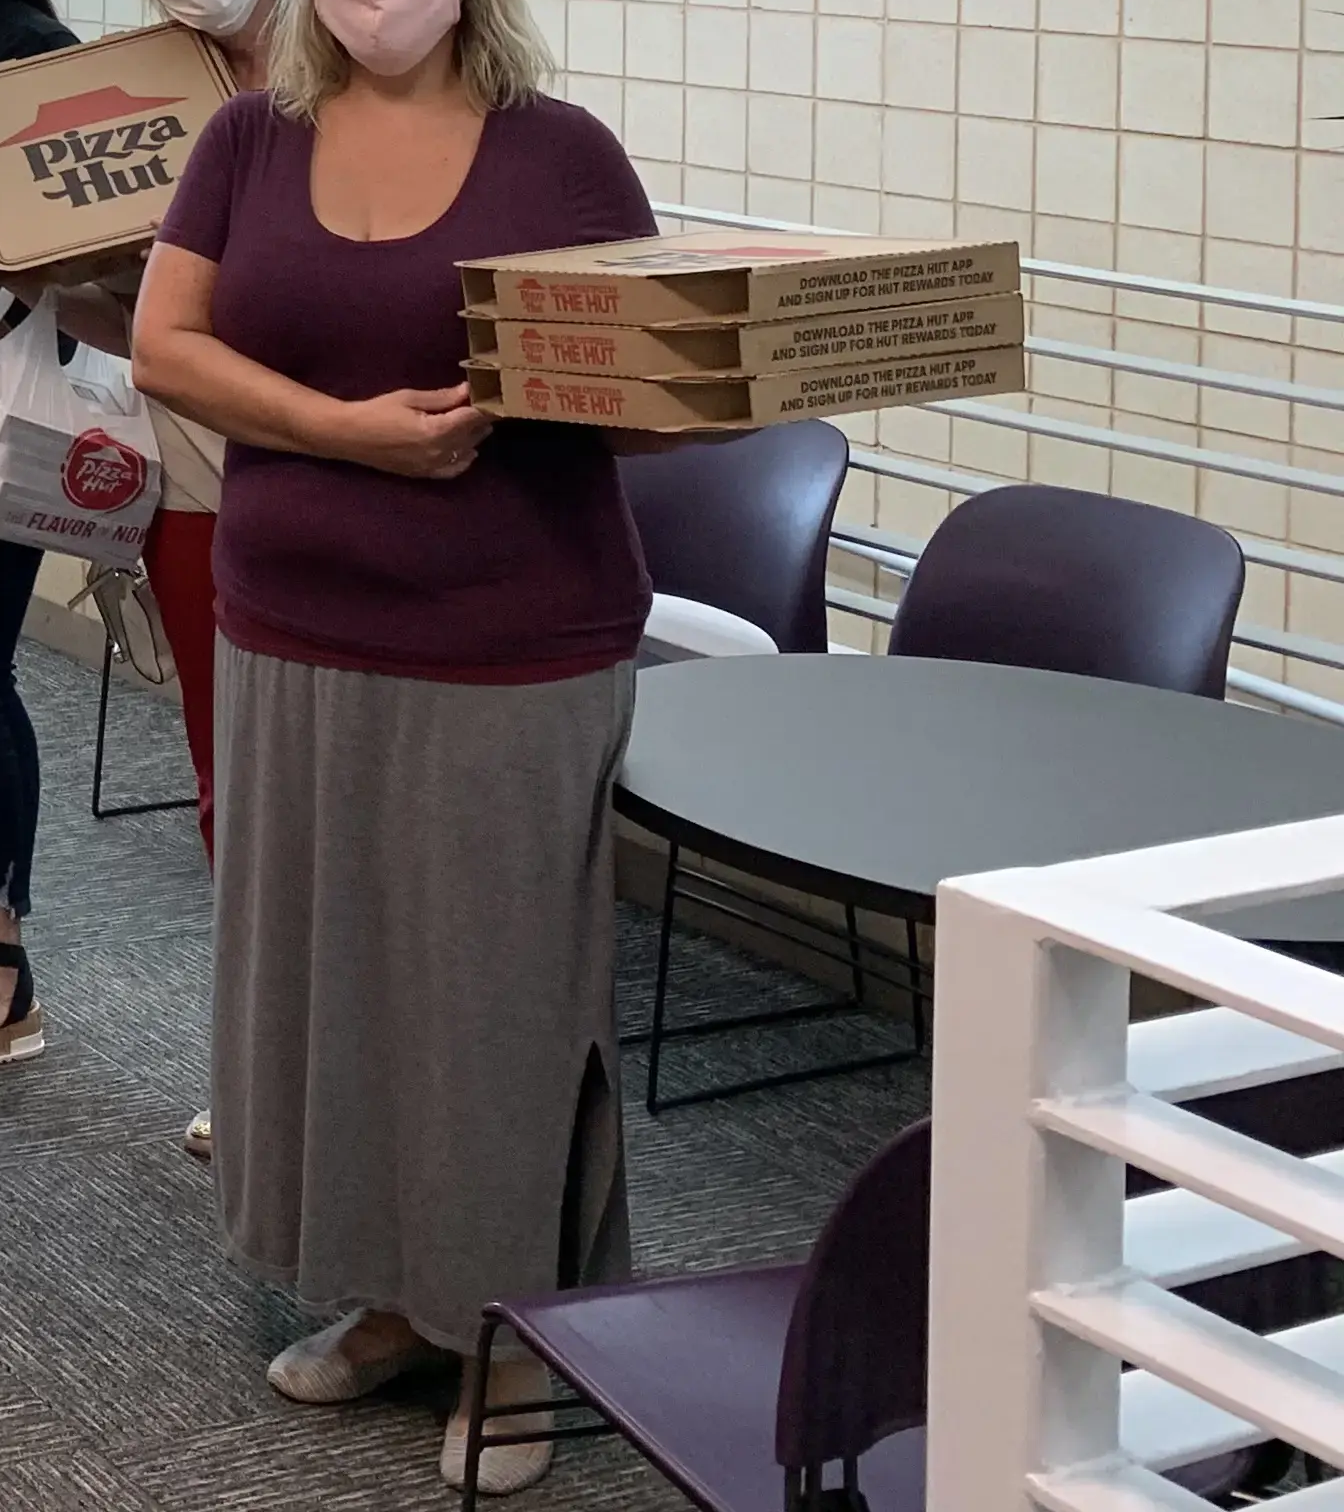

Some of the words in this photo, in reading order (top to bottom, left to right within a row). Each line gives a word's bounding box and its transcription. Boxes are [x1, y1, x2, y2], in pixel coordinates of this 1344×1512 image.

[20, 115, 188, 182] Pizza
[42, 155, 175, 208] Hut
[778, 294, 801, 307] AND
[805, 290, 833, 304] SIGN
[835, 288, 849, 300] UP
[853, 285, 876, 298] FOR
[878, 282, 900, 296] HUT
[902, 276, 954, 292] REWARDS
[958, 271, 994, 285] TODAY
[800, 271, 867, 290] DOWNLOAD
[872, 268, 891, 280] THE
[893, 264, 924, 278] PIZZA
[927, 261, 949, 274] HUT
[952, 259, 973, 270] APP
[551, 292, 583, 312] THE
[586, 294, 620, 314] HUT
[772, 348, 797, 361] AND
[800, 344, 828, 358] SIGN
[831, 341, 846, 353] UP
[850, 338, 873, 351] FOR
[876, 335, 898, 348] HUT
[902, 328, 956, 345] REWARDS
[959, 323, 997, 337] TODAY
[794, 324, 864, 343] DOWNLOAD
[868, 320, 889, 333] THE
[892, 316, 923, 330] PIZZA
[927, 314, 949, 327] HUT
[952, 311, 974, 323] APP
[550, 343, 581, 363] THE
[584, 345, 616, 366] HUT
[801, 373, 869, 393] DOWNLOAD
[873, 370, 893, 383] THE
[895, 366, 926, 379] PIZZA
[930, 362, 951, 375] HUT
[954, 359, 976, 372] APP
[555, 392, 589, 413] THE
[590, 396, 626, 417] HUT
[780, 398, 804, 412] AND
[807, 393, 835, 407] SIGN
[838, 390, 852, 403] UP
[856, 387, 878, 400] FOR
[881, 384, 902, 396] HUT
[906, 376, 958, 393] REWARDS
[961, 372, 997, 386] TODAY
[76, 460, 132, 481] Pizza
[81, 476, 123, 492] Hut
[26, 512, 97, 538] FLAVOR
